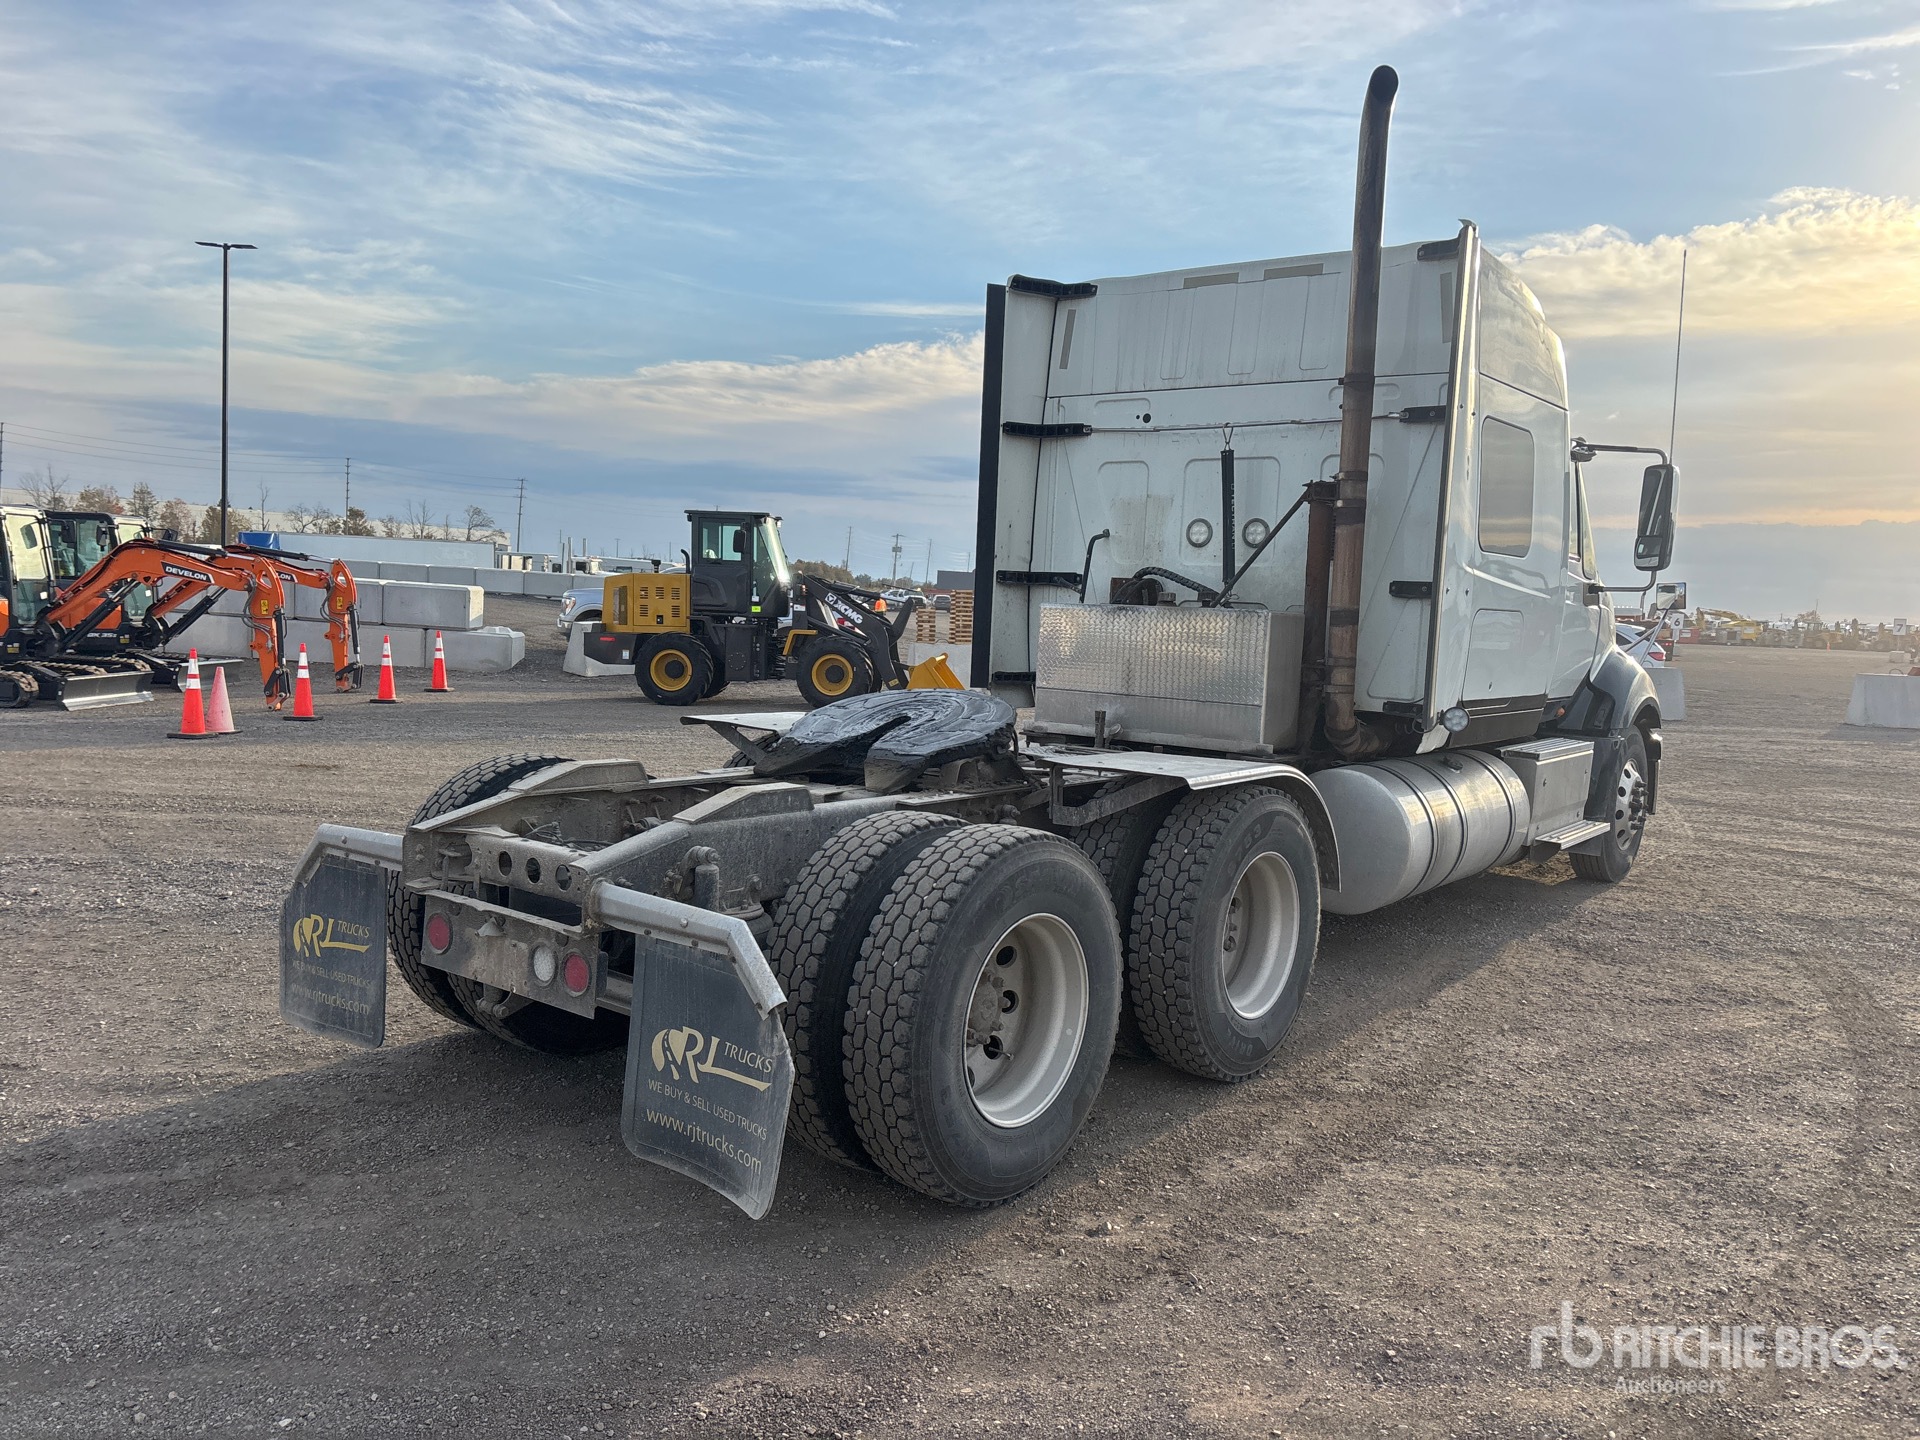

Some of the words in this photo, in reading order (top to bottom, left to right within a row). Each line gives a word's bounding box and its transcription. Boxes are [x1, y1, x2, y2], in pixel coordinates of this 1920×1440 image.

[165, 566, 208, 581] DEVELON
[833, 600, 863, 624] XCMG
[1674, 618, 1681, 627] 6
[1896, 623, 1904, 633] 7
[337, 920, 370, 938] TRUCKS
[724, 1041, 773, 1073] TRUCKS
[648, 1079, 662, 1094] WE
[664, 1085, 683, 1100] BUY
[684, 1091, 691, 1105] &
[692, 1095, 711, 1113] SELL
[713, 1103, 735, 1124] USED
[736, 1114, 768, 1141] TRUCKS
[646, 1108, 762, 1175] www.rjtrucks.com
